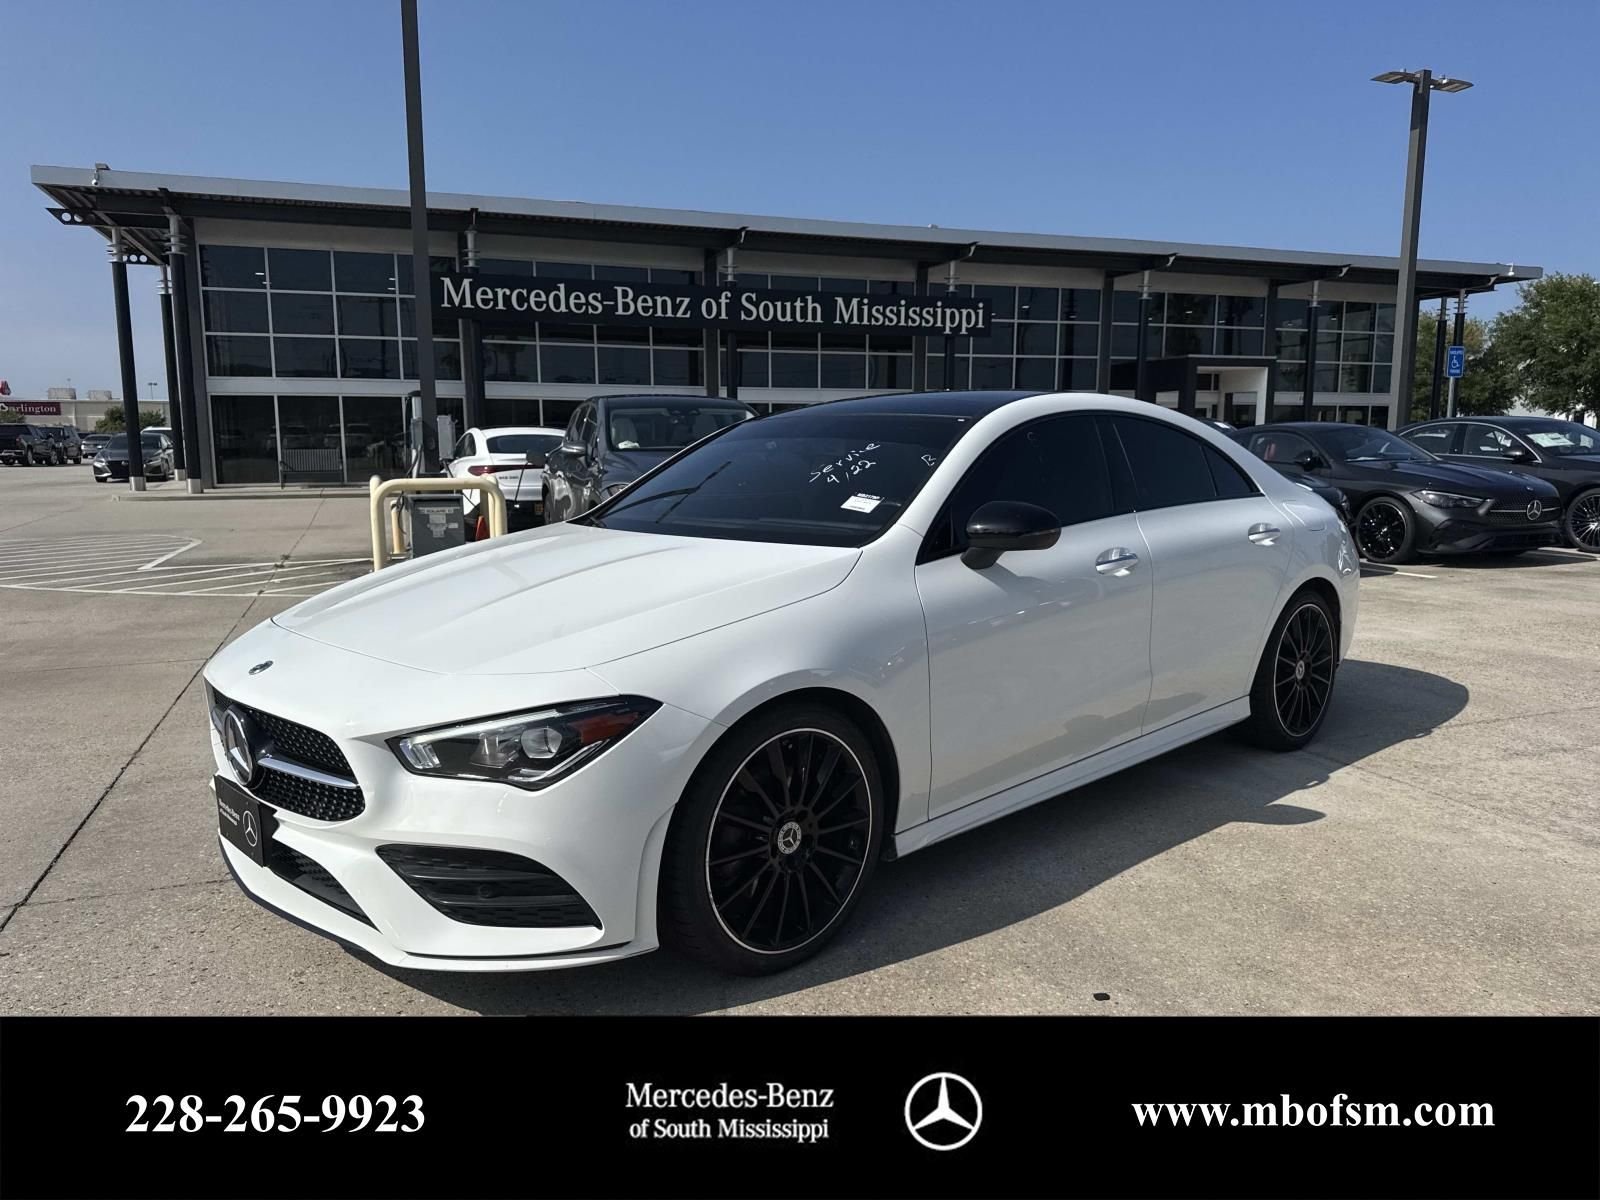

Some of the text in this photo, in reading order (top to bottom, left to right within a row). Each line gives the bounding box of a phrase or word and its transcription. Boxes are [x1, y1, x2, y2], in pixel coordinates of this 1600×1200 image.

[439, 276, 985, 335] Mercedes-Benz of South Mississippi
